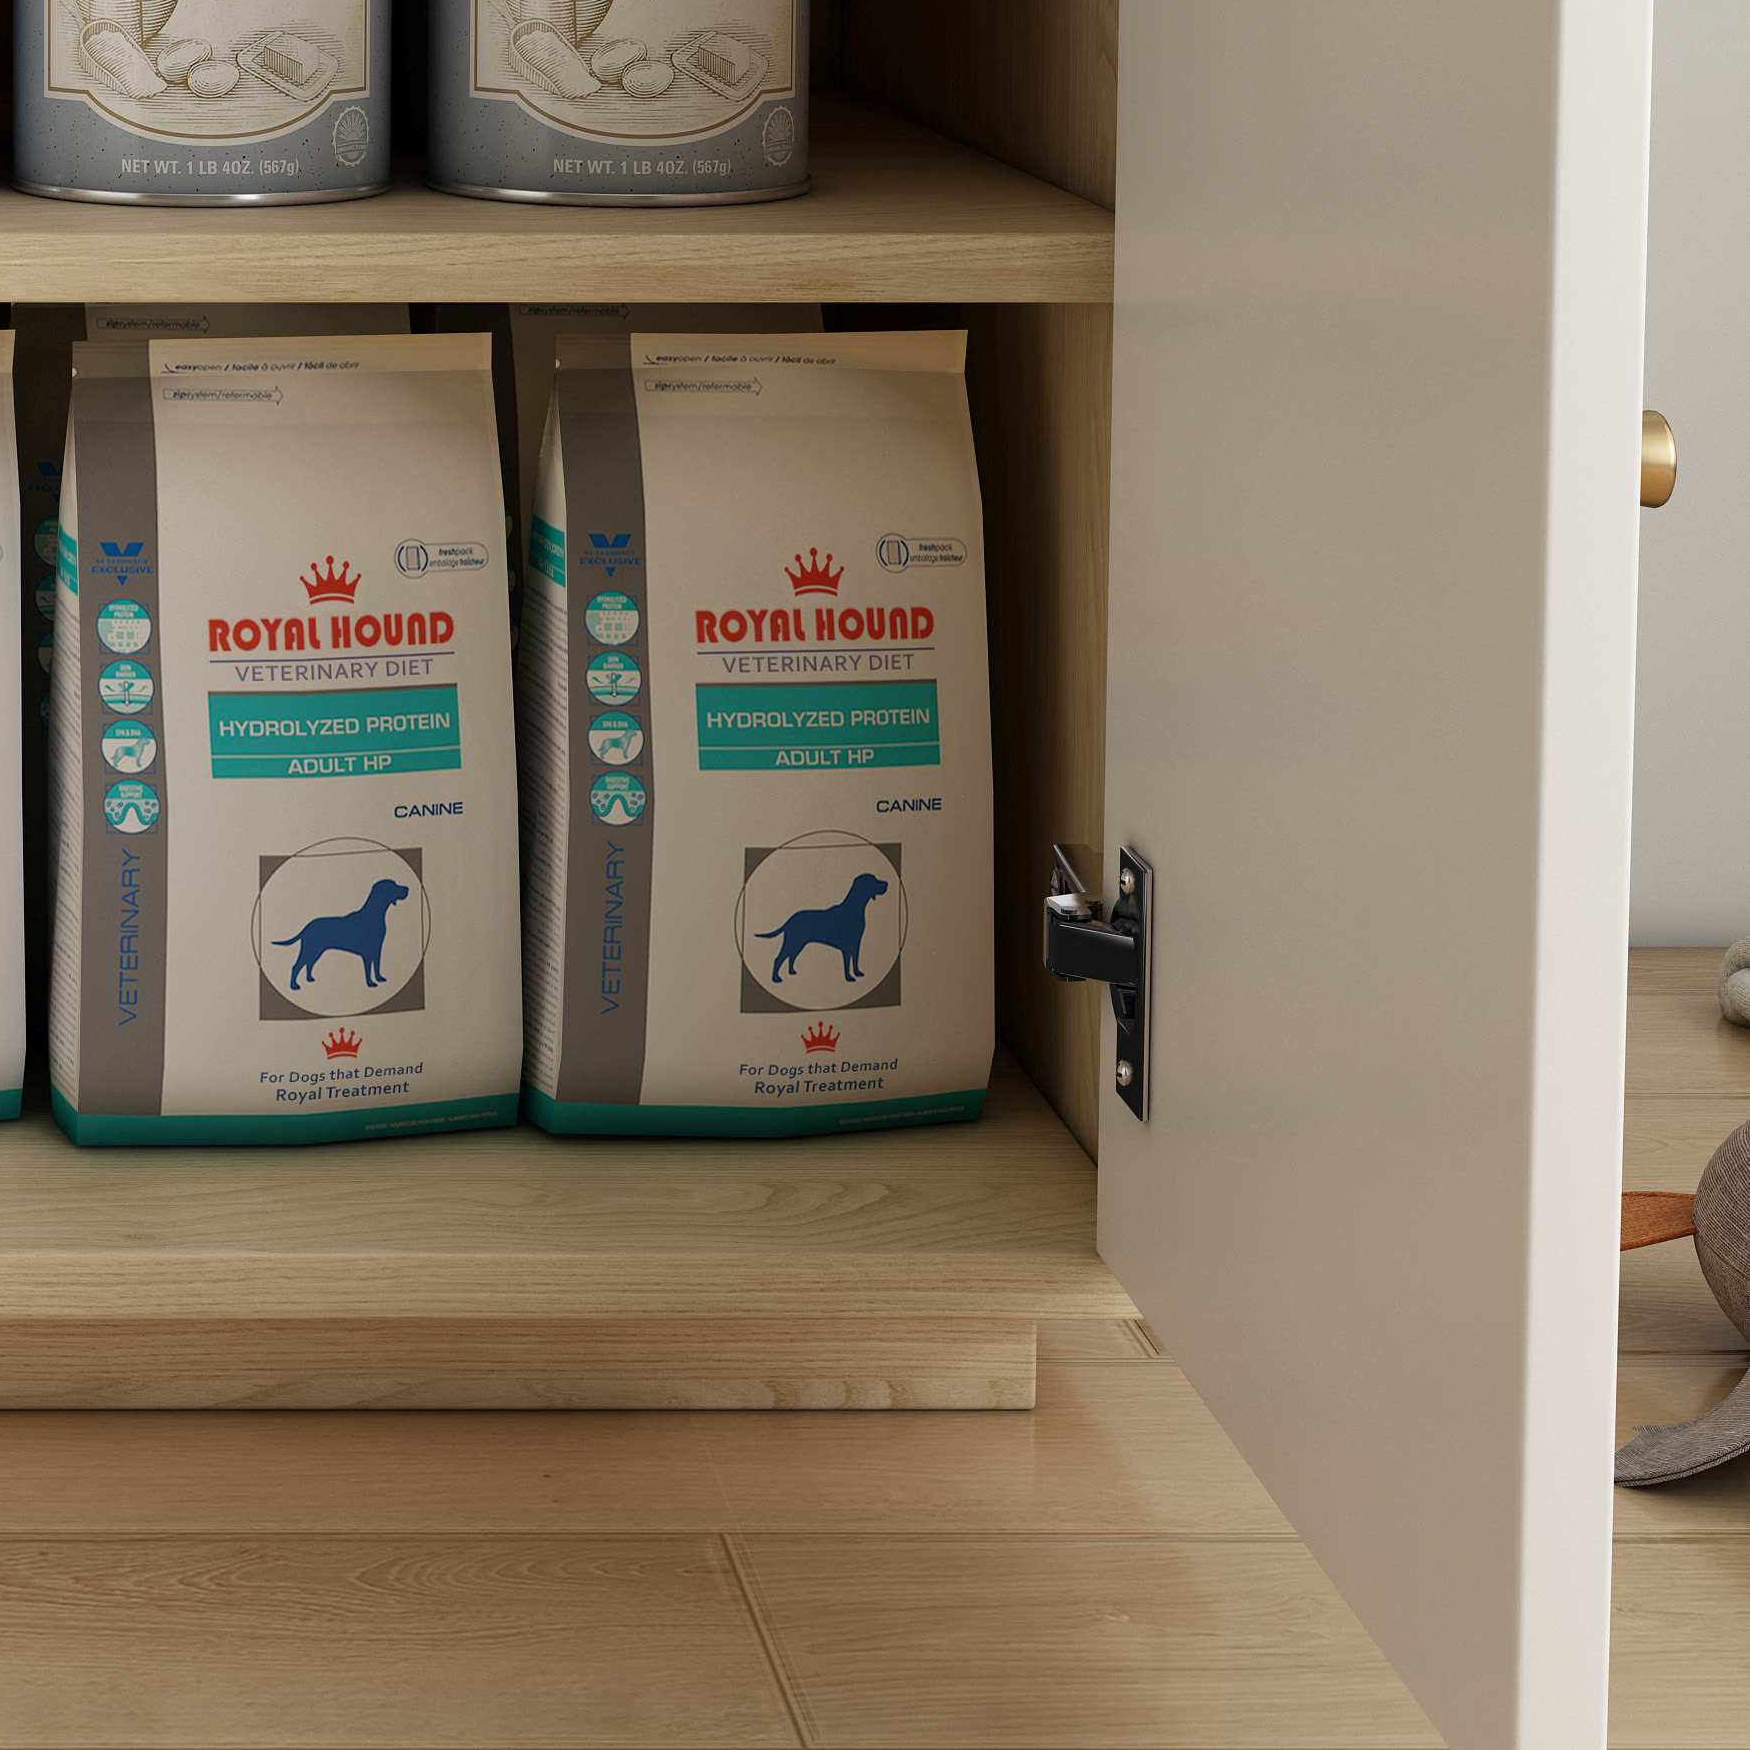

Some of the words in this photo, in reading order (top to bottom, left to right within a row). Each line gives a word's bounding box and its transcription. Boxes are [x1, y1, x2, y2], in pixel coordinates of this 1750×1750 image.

[121, 158, 149, 174] NET
[154, 159, 181, 175] WT.
[186, 160, 193, 175] 1
[198, 160, 218, 175] LB
[259, 158, 300, 177] (567g)
[553, 158, 582, 174] NET
[587, 159, 615, 175] WT.
[620, 160, 627, 175] 1
[633, 160, 652, 175] LB
[693, 158, 731, 177] (567g)
[209, 618, 321, 651] ROYAL
[331, 611, 455, 649] HOUND
[696, 609, 806, 642] ROYAL
[815, 605, 934, 643] HOUND
[236, 662, 379, 682] VETERINARY
[386, 658, 434, 677] DIET
[723, 654, 862, 674] VETERINARY
[869, 652, 915, 672] DIET
[218, 717, 360, 737] HYDROLYZED
[366, 712, 451, 733] PROTEIN
[706, 708, 845, 729] HYDROLYZED
[850, 706, 930, 728] PROTEIN
[288, 756, 356, 775] ADULT
[363, 755, 392, 771] HP
[775, 748, 840, 768] ADULT
[847, 749, 875, 765] HP
[393, 802, 462, 818] CANINE
[876, 797, 941, 814] CANINE
[118, 849, 141, 1026] VETERINARY
[600, 841, 627, 1015] VETERINARY
[260, 1071, 283, 1083] For
[289, 1071, 325, 1086] Dogs
[329, 1068, 360, 1081] that
[364, 1062, 422, 1078] Demand
[739, 1063, 763, 1076] For
[768, 1064, 803, 1079] Dogs
[808, 1062, 837, 1075] that
[841, 1057, 897, 1074] Demand
[276, 1087, 321, 1104] Royal
[326, 1081, 409, 1099] Treatment
[755, 1080, 798, 1097] Royal
[803, 1076, 884, 1094] Treatment
